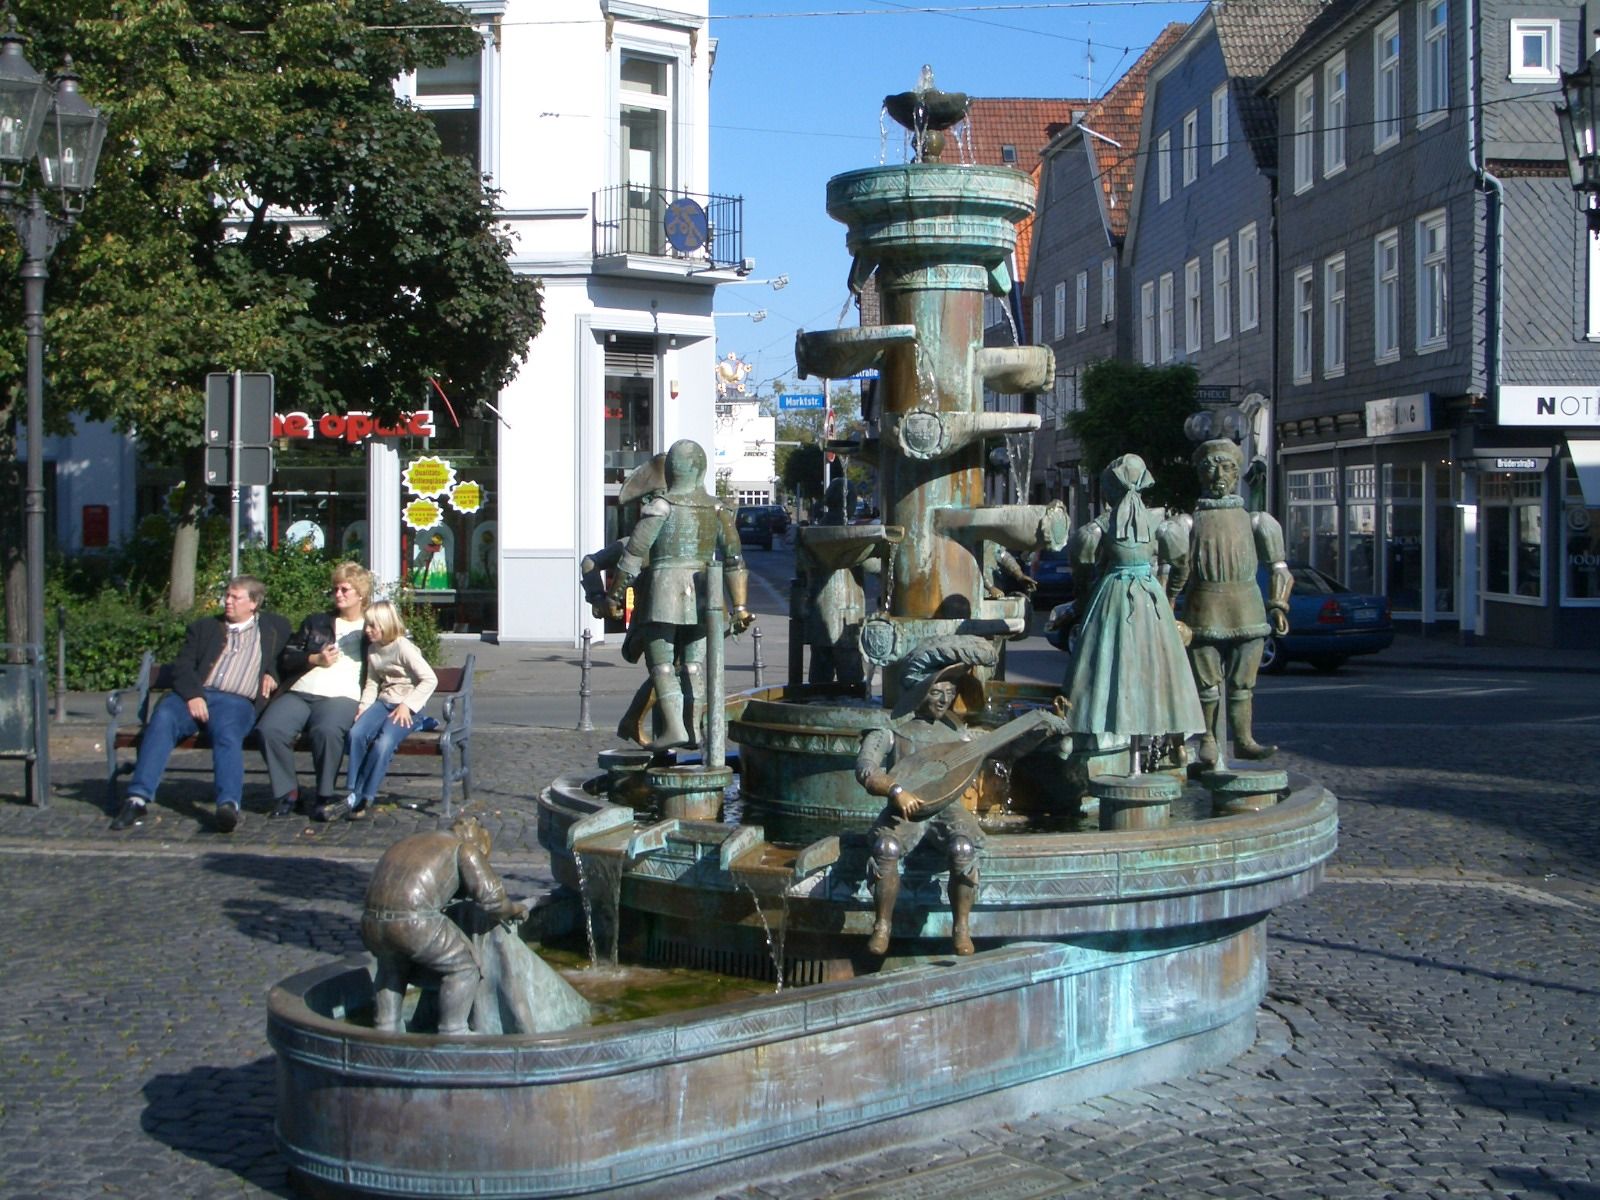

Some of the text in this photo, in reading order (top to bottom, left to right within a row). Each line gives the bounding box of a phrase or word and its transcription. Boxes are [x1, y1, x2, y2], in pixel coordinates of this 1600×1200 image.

[785, 396, 820, 406] Marktstr.
[1537, 396, 1600, 416] NOT
[1497, 458, 1535, 468] Brüderstraße
